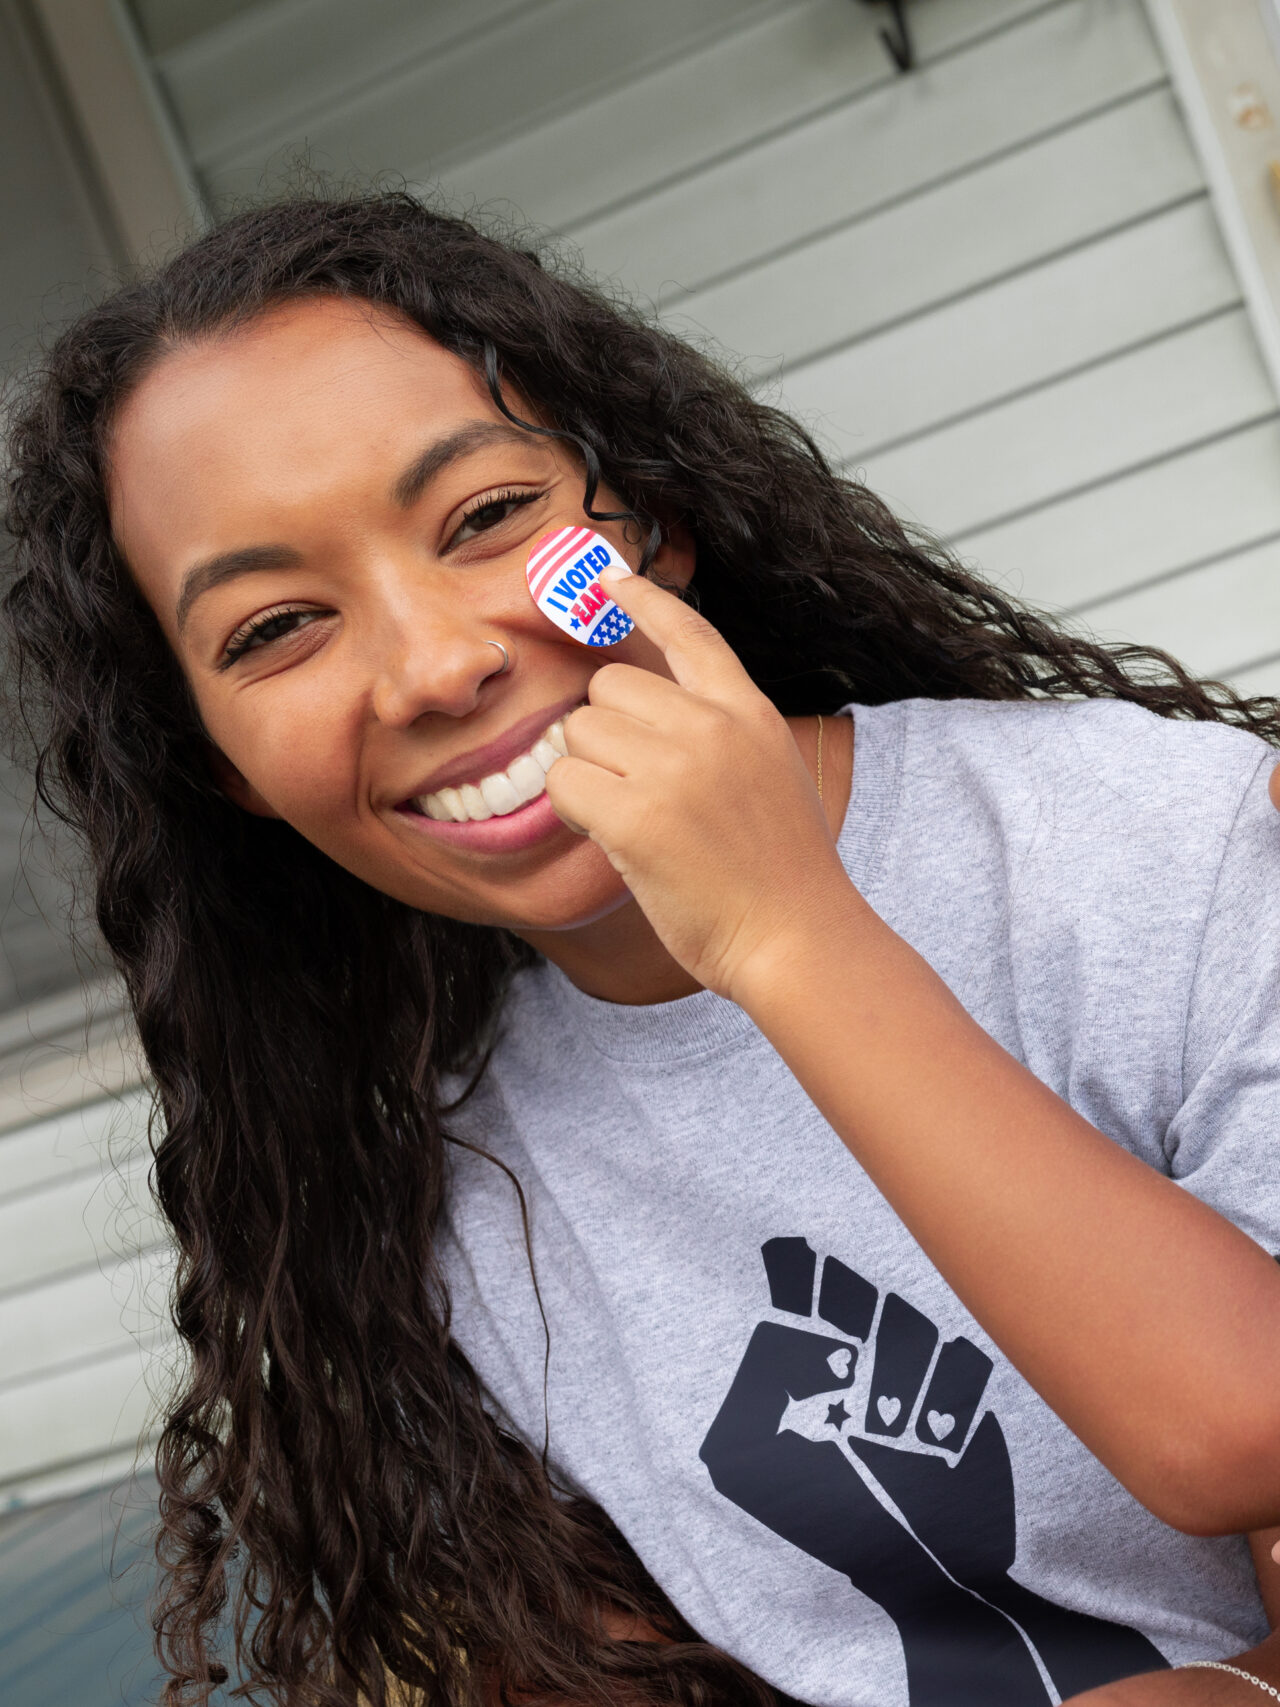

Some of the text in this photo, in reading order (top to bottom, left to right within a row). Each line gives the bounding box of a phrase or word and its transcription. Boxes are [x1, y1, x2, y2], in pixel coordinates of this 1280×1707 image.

[546, 545, 611, 613] I VOTED
[570, 582, 611, 627] EAR
